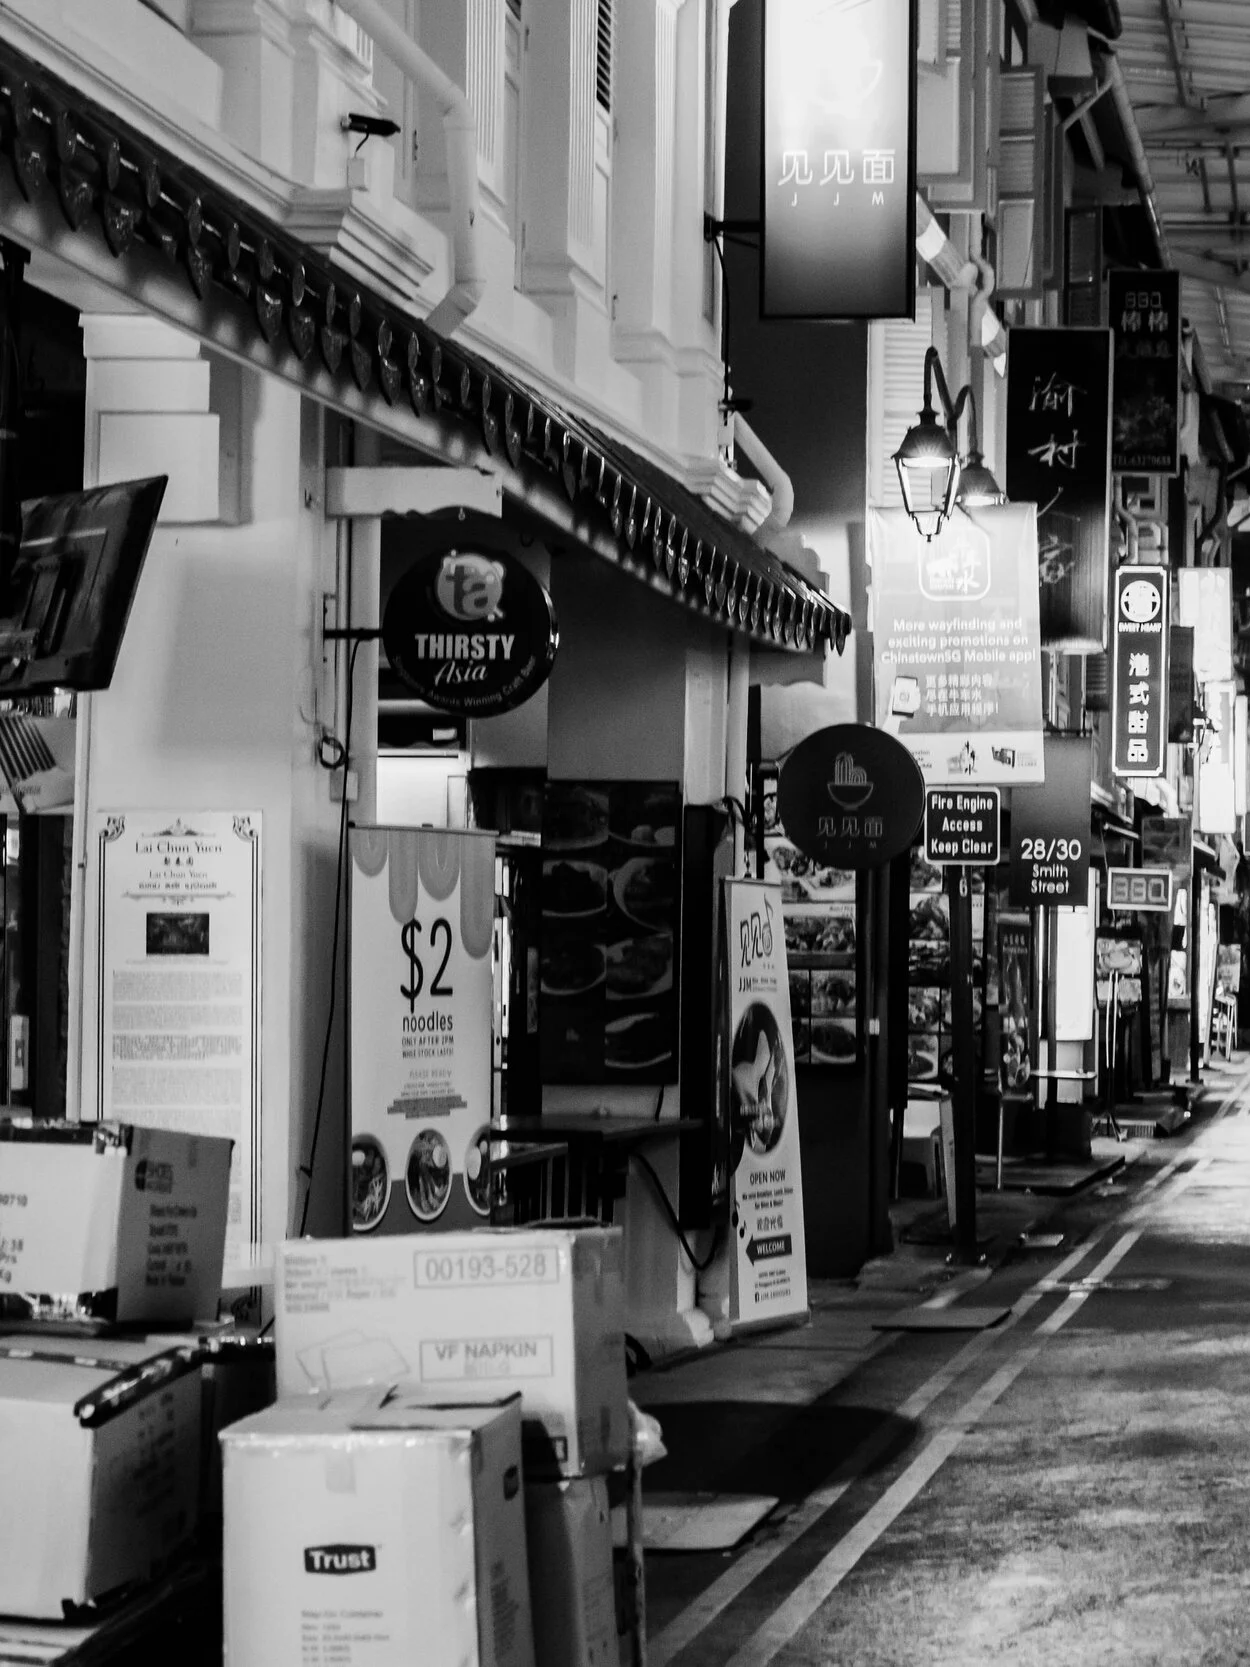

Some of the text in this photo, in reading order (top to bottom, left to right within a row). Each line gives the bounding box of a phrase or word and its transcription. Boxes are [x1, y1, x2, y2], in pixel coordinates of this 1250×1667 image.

[777, 148, 896, 187] 见见面
[893, 616, 1023, 634] More wayfinding and
[414, 633, 516, 661] THIRSTY
[888, 632, 1029, 649] exciting promotions on
[964, 649, 1006, 662] Mobile
[434, 658, 488, 688] Asia
[931, 794, 993, 814] Fire Engine
[941, 816, 983, 833] Access
[135, 841, 222, 854] Lai Chun Yuen
[931, 838, 993, 857] Keep Clear
[1020, 837, 1082, 862] 28/30
[1032, 862, 1069, 879] Smith
[1030, 878, 1070, 894] Street
[1111, 876, 1168, 902] BBQ
[400, 917, 454, 1015] $2
[739, 976, 752, 993] JJM
[402, 1010, 454, 1034] noodles
[401, 1033, 454, 1047] ONLY AFTER 2PM
[418, 1047, 435, 1058] STOCK
[750, 1169, 786, 1185] OPEN NOW
[756, 1239, 786, 1256] WELCOME
[425, 1252, 547, 1281] 00193-528
[464, 1341, 538, 1359] NAPKIN
[309, 1549, 371, 1571] Trust
